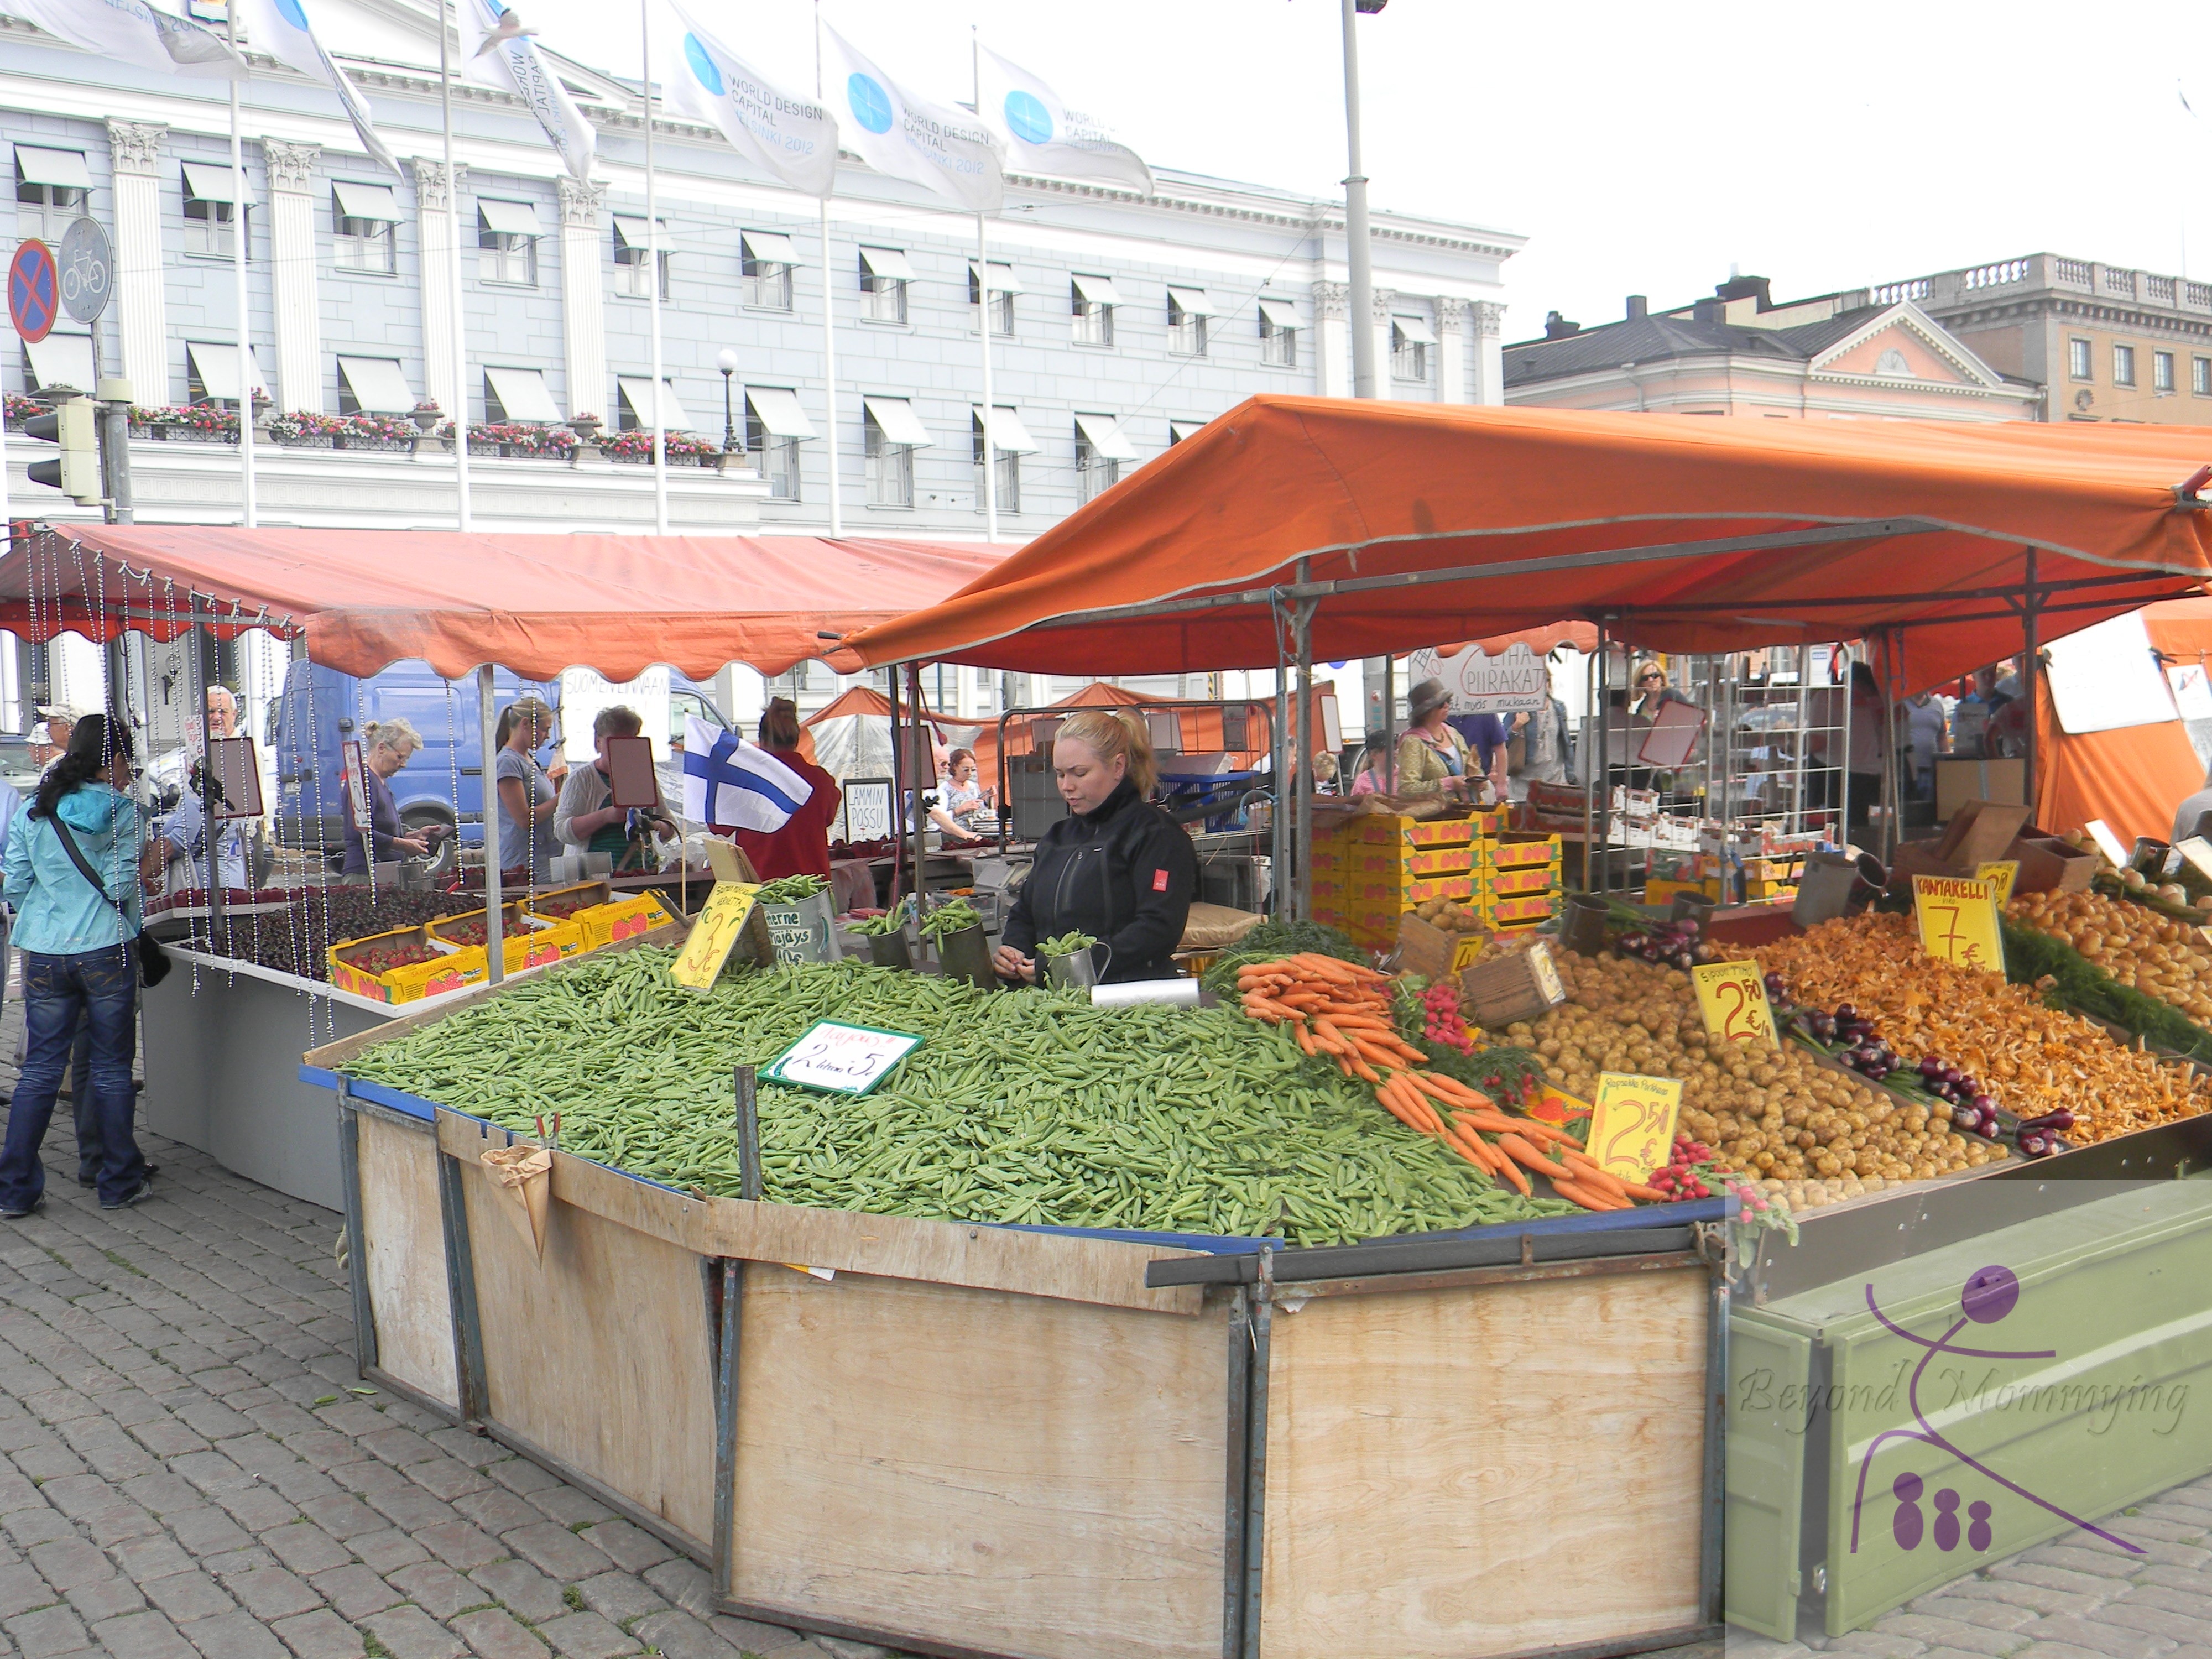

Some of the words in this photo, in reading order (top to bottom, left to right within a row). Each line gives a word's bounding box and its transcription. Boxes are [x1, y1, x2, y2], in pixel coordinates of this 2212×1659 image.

[728, 72, 771, 106] WORLD
[775, 97, 822, 121] DESIGN
[732, 89, 776, 127] CAPITAL
[901, 103, 939, 134] WORLD
[944, 126, 989, 145] DESIGN
[904, 118, 947, 152] CAPITAL
[785, 135, 814, 155] 2012
[956, 159, 985, 175] 2012
[1467, 669, 1545, 693] PIIRAKAT
[1465, 700, 1488, 711] myös
[1496, 697, 1540, 708] mukaan
[848, 787, 884, 806] LÄMMIN
[852, 808, 883, 828] POSSU
[1917, 878, 1989, 900] KANTARELLI
[1928, 906, 1967, 963] 7
[792, 1043, 828, 1068] 2
